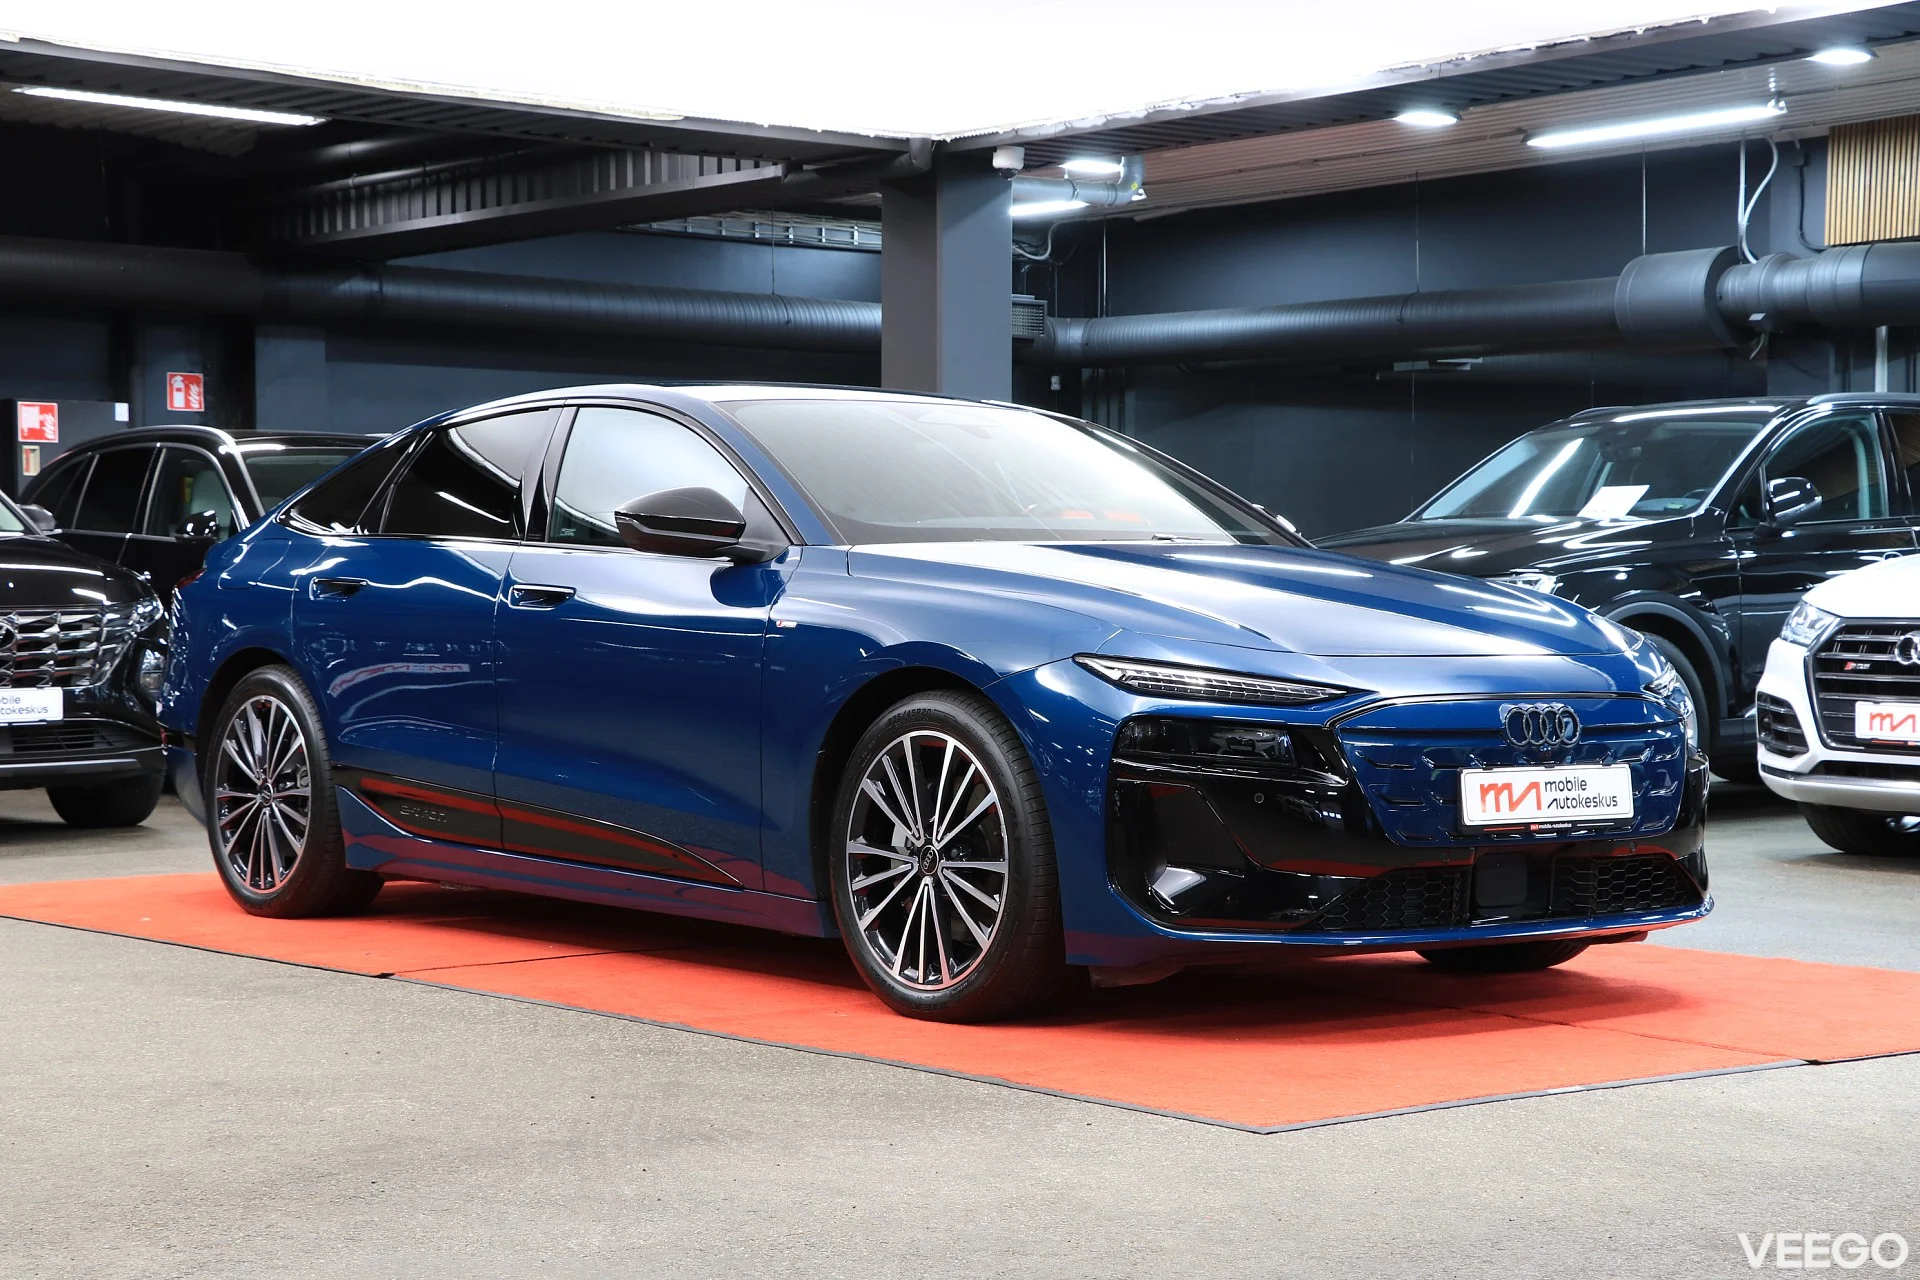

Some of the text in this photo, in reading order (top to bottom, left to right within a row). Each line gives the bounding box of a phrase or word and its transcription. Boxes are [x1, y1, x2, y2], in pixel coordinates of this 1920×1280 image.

[0, 696, 21, 705] bile
[0, 706, 49, 715] tokeskus
[1544, 776, 1587, 793] mobile
